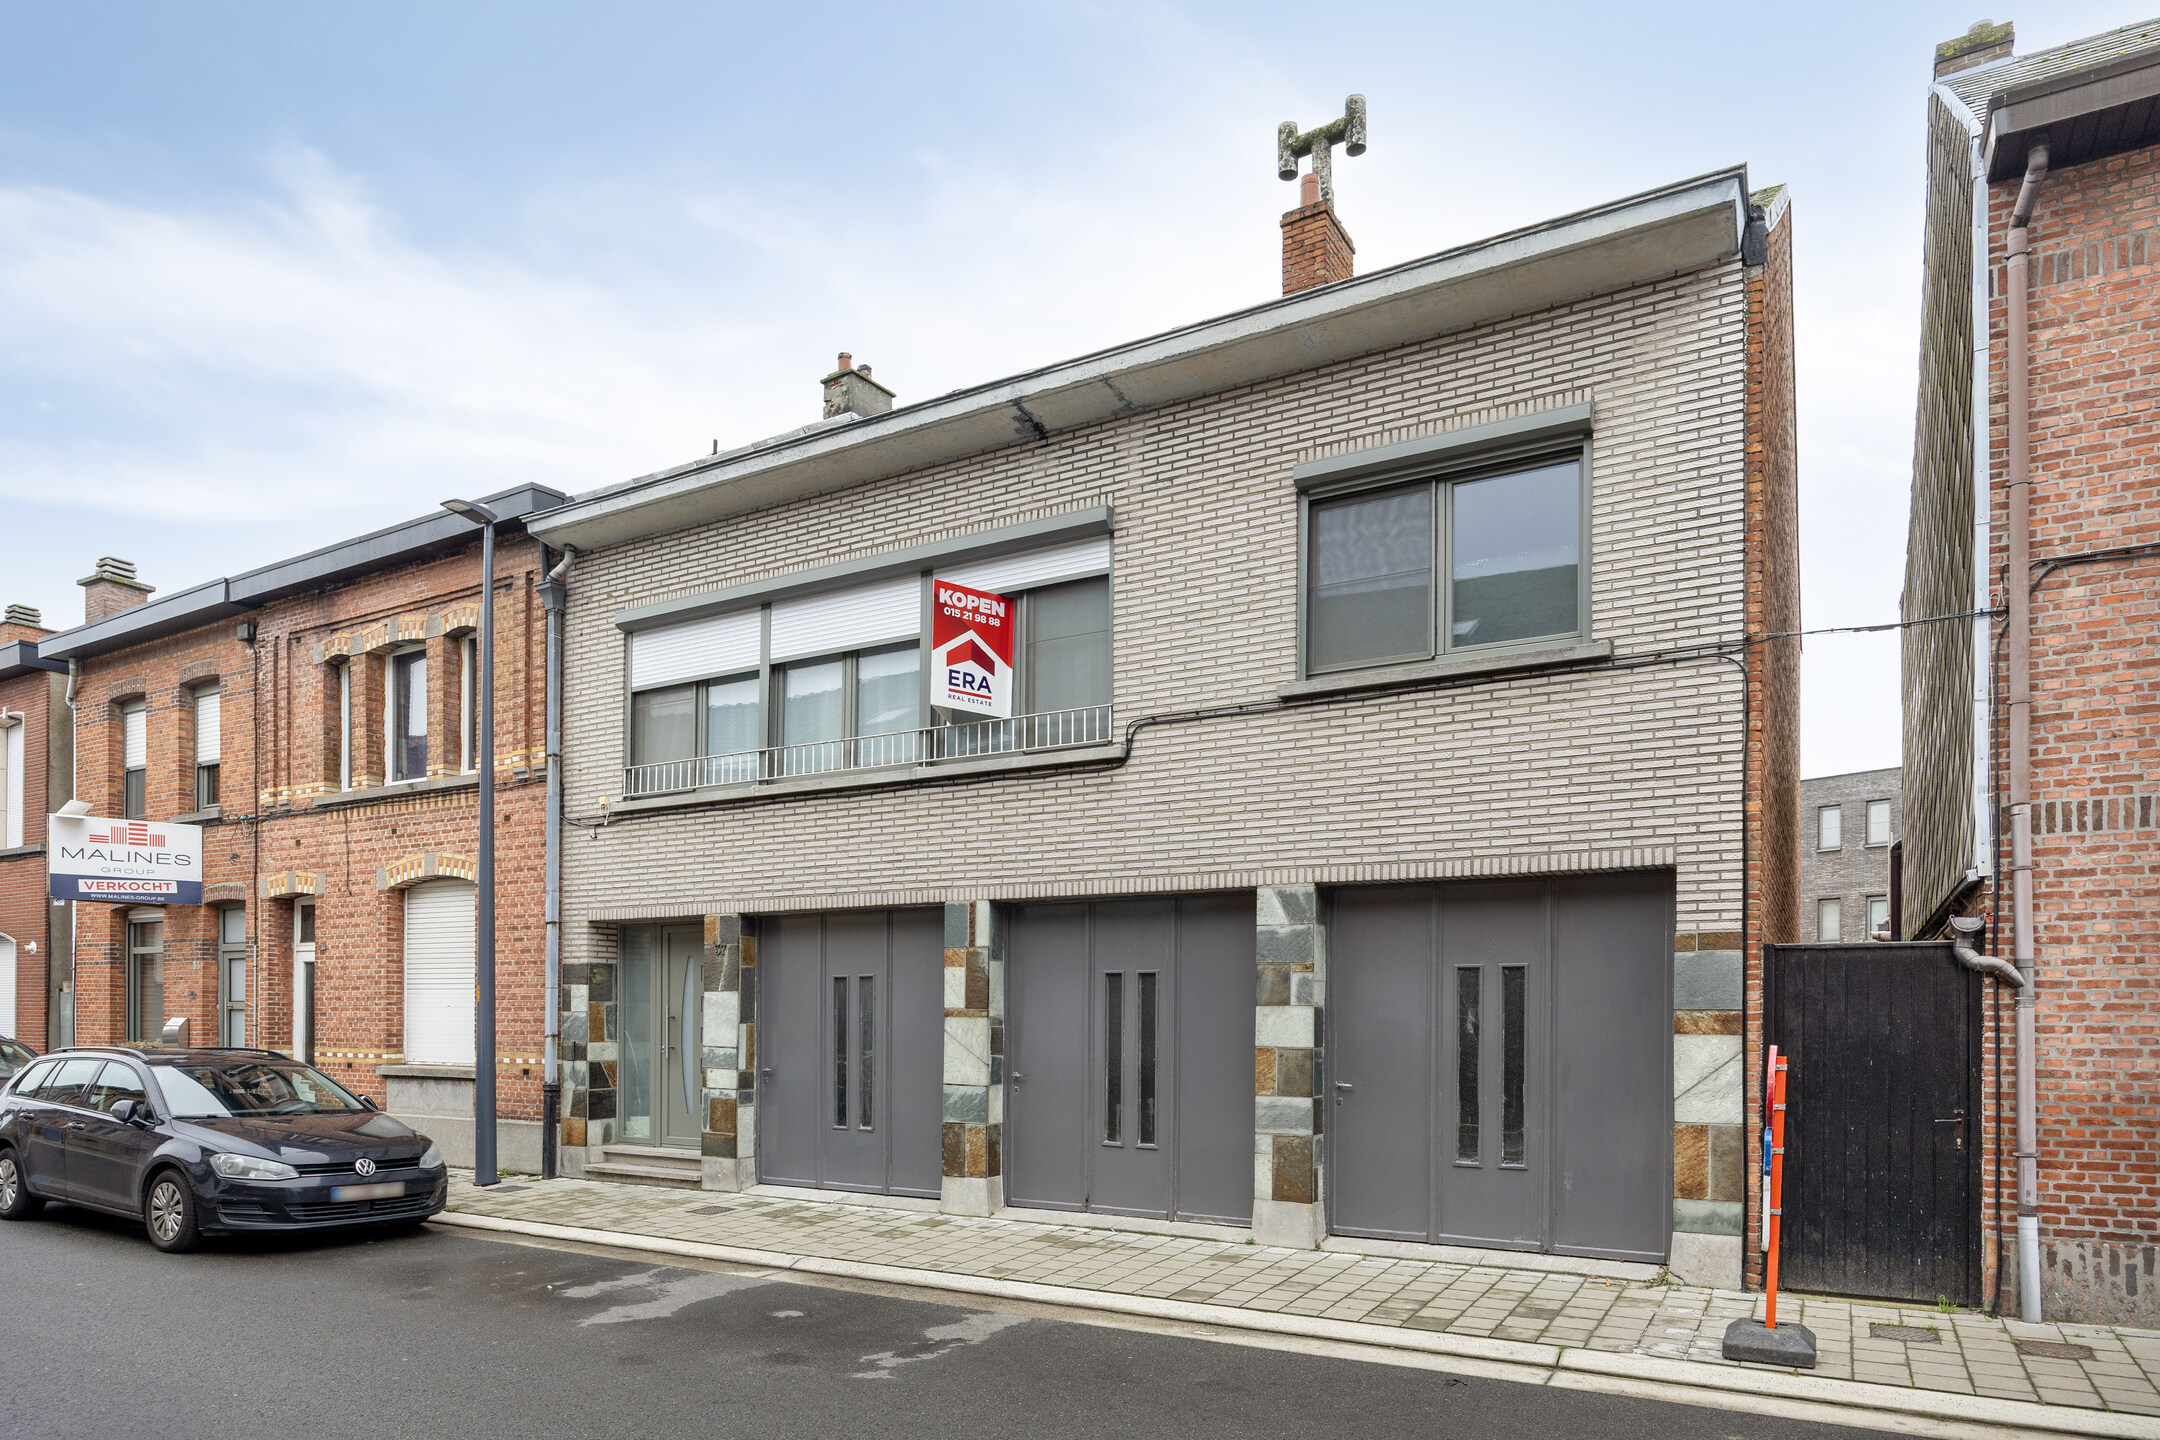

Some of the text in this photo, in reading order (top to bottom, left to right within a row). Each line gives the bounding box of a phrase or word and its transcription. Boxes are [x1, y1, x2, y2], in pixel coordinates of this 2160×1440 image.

[939, 588, 1005, 617] KOPEN
[944, 607, 1000, 626] 015 21 98 88
[948, 669, 992, 694] ERA
[947, 693, 992, 707] REAL ESTATE
[61, 846, 191, 866] MALINES
[100, 866, 155, 875] GROUP
[84, 881, 172, 891] VERKOCHT
[90, 893, 165, 901] WWW.MALINES-GROUP.BE
